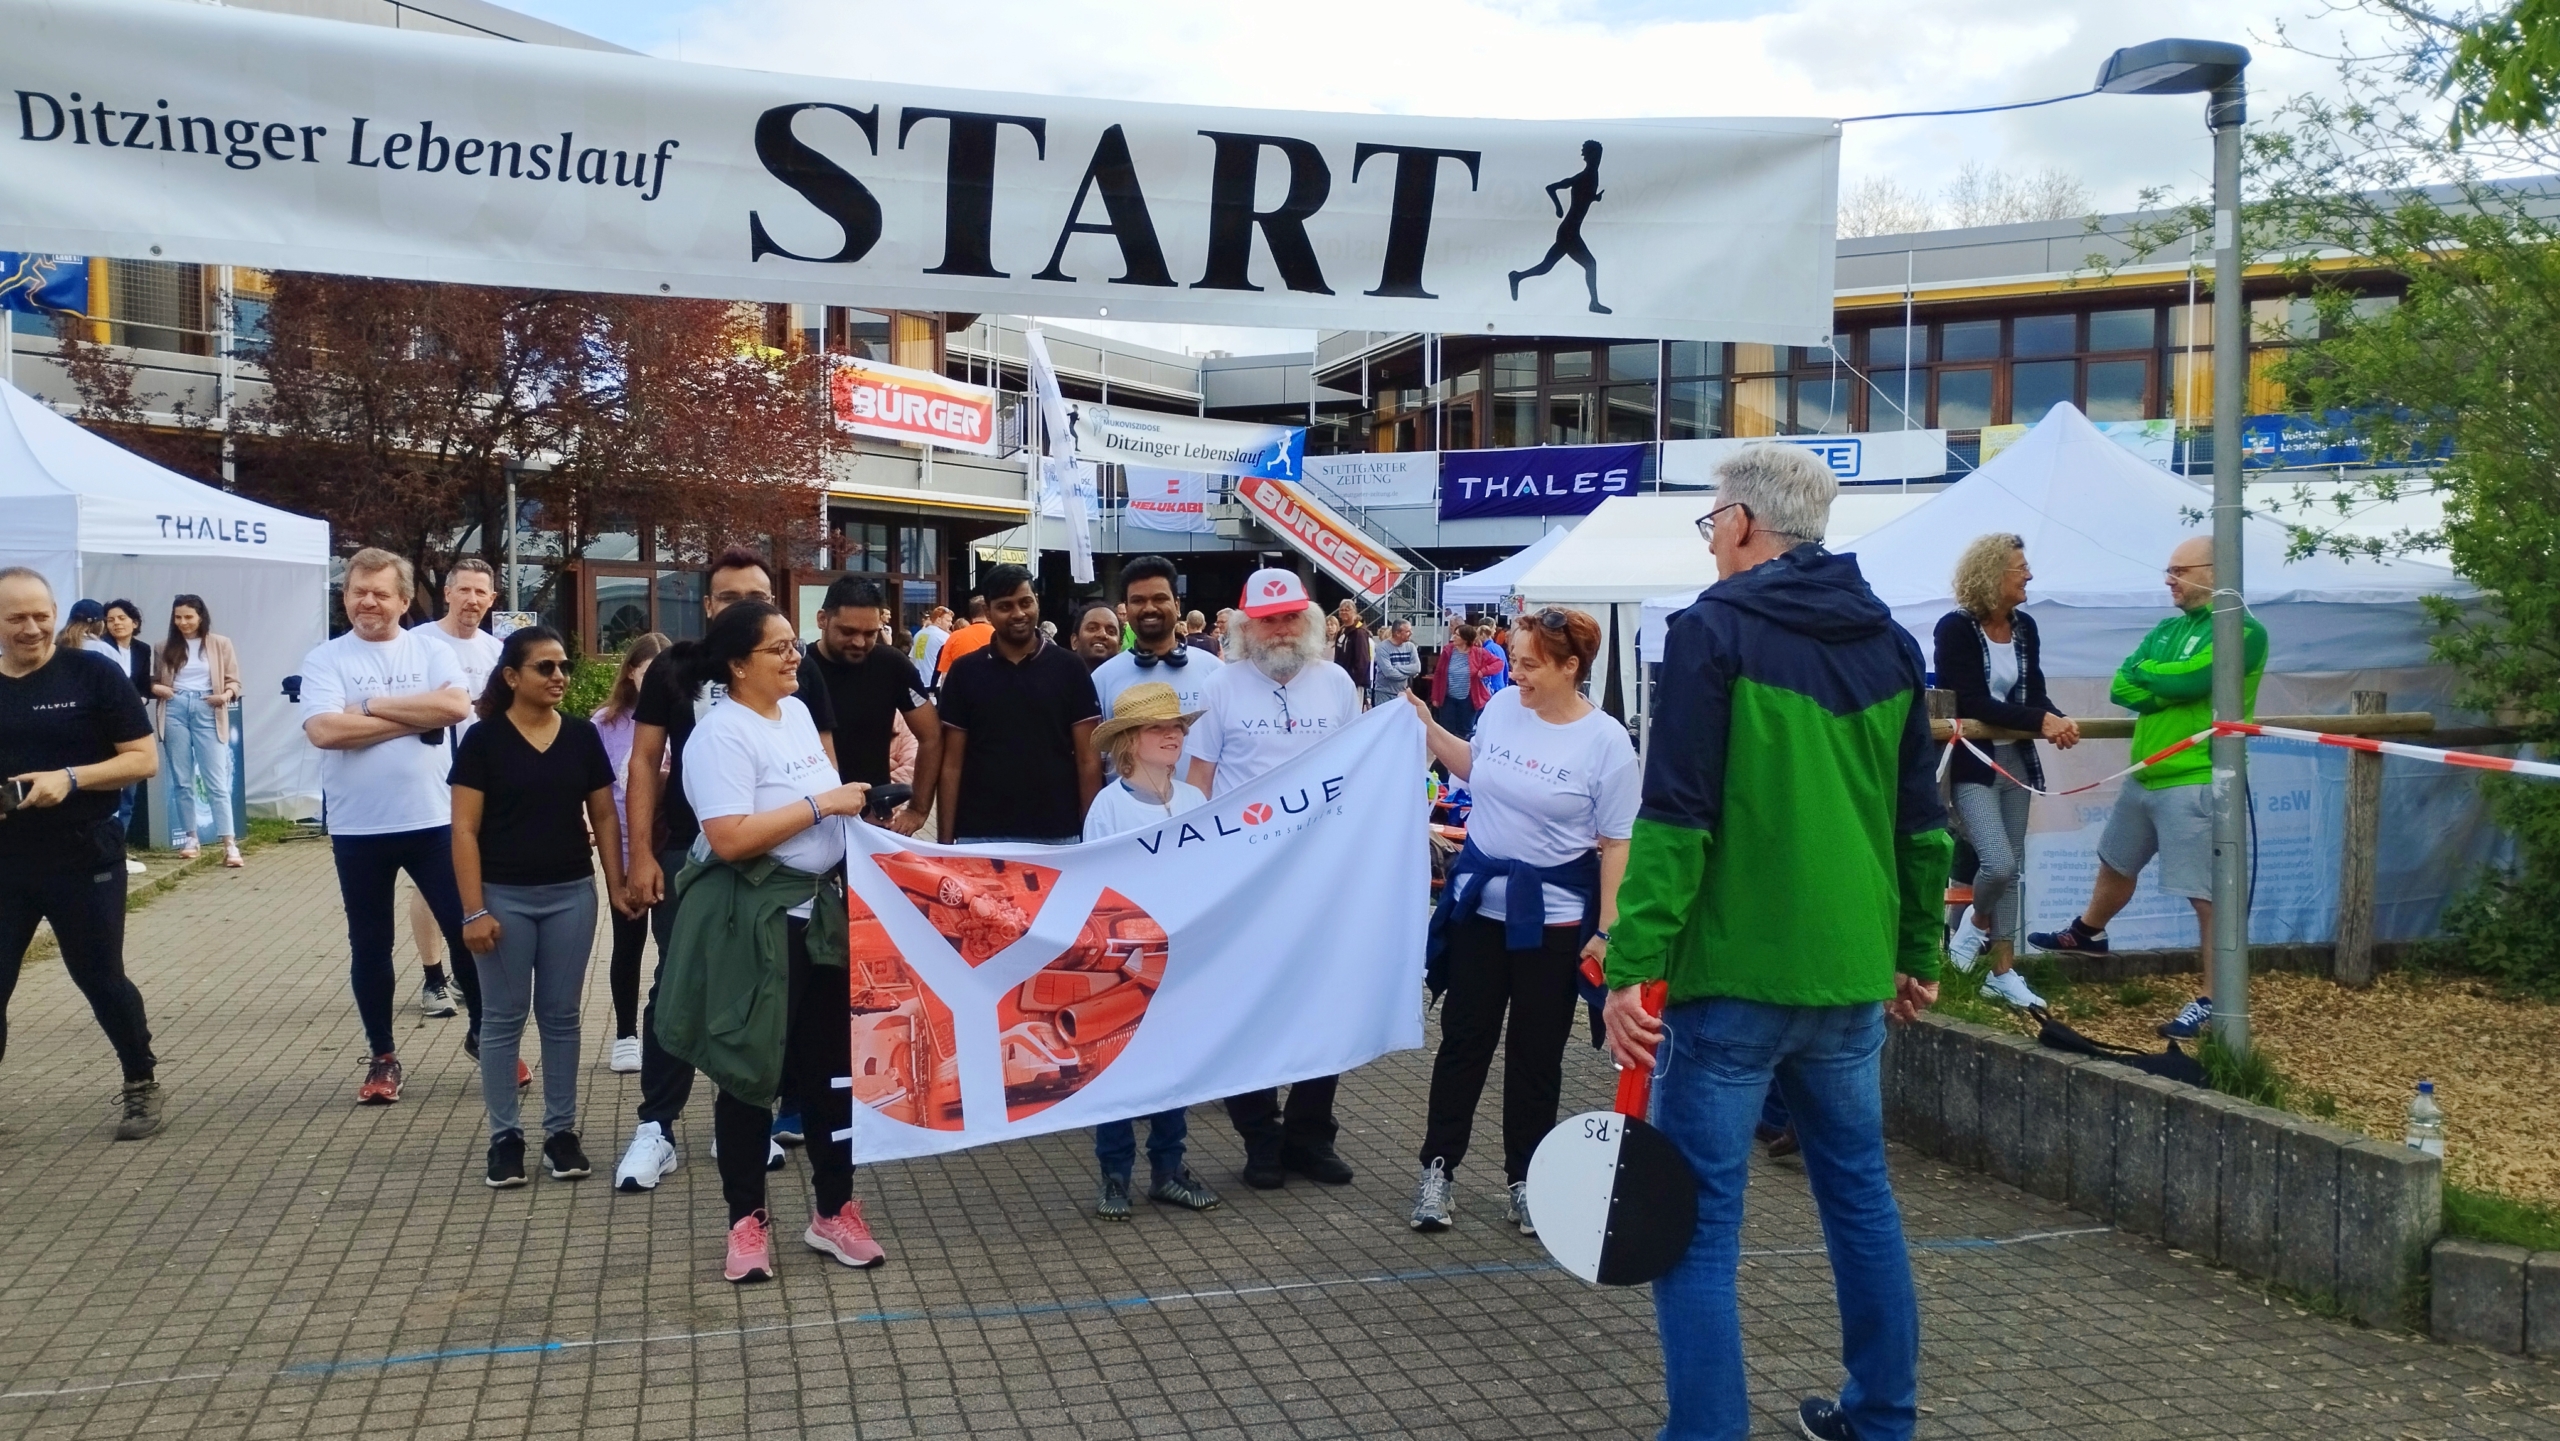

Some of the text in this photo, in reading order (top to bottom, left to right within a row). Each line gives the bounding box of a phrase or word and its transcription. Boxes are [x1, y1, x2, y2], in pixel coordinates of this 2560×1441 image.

[14, 90, 680, 201] Ditzinger Lebenslauf
[751, 102, 1482, 299] START
[851, 382, 982, 438] BÜRGER
[1103, 418, 1161, 433] MUKOVISZIDOSE
[1105, 433, 1266, 468] Ditzinger Lebenslauf
[1322, 462, 1407, 475] STUTTGARTER
[1336, 474, 1391, 486] ZEITUNG
[1458, 468, 1628, 500] THALES
[156, 514, 267, 544] THALES
[1254, 481, 1381, 585] BÜRGER
[1248, 804, 1344, 845] Consulting
